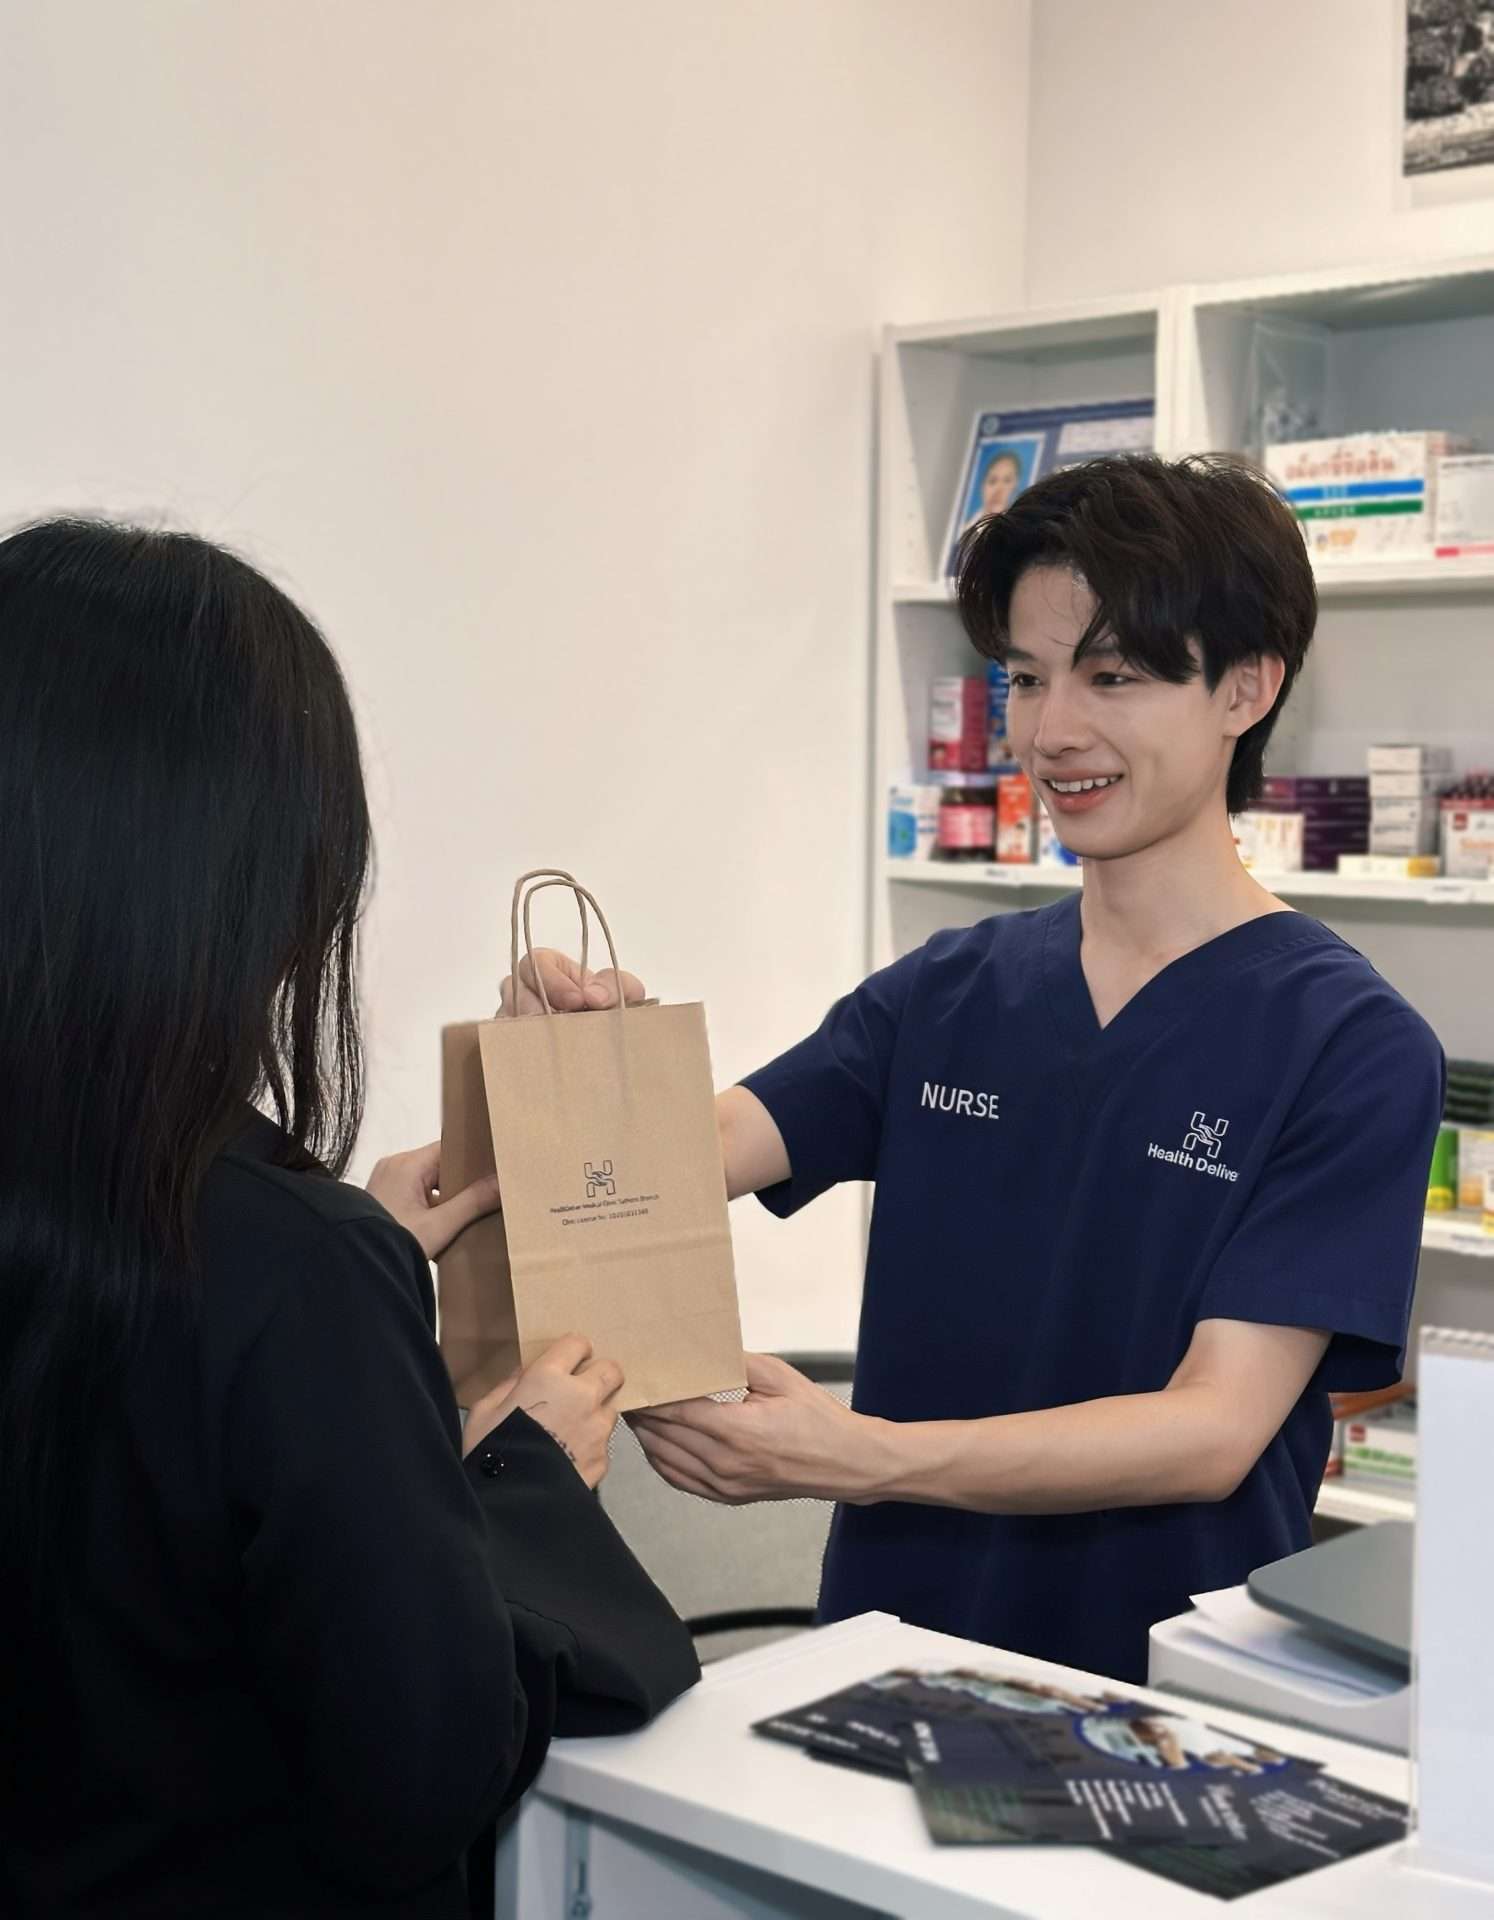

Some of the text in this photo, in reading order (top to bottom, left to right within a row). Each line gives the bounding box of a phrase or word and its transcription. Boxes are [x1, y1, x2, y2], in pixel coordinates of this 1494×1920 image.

[921, 1081, 999, 1119] NURSE
[1147, 1143, 1239, 1182] Health Delive
